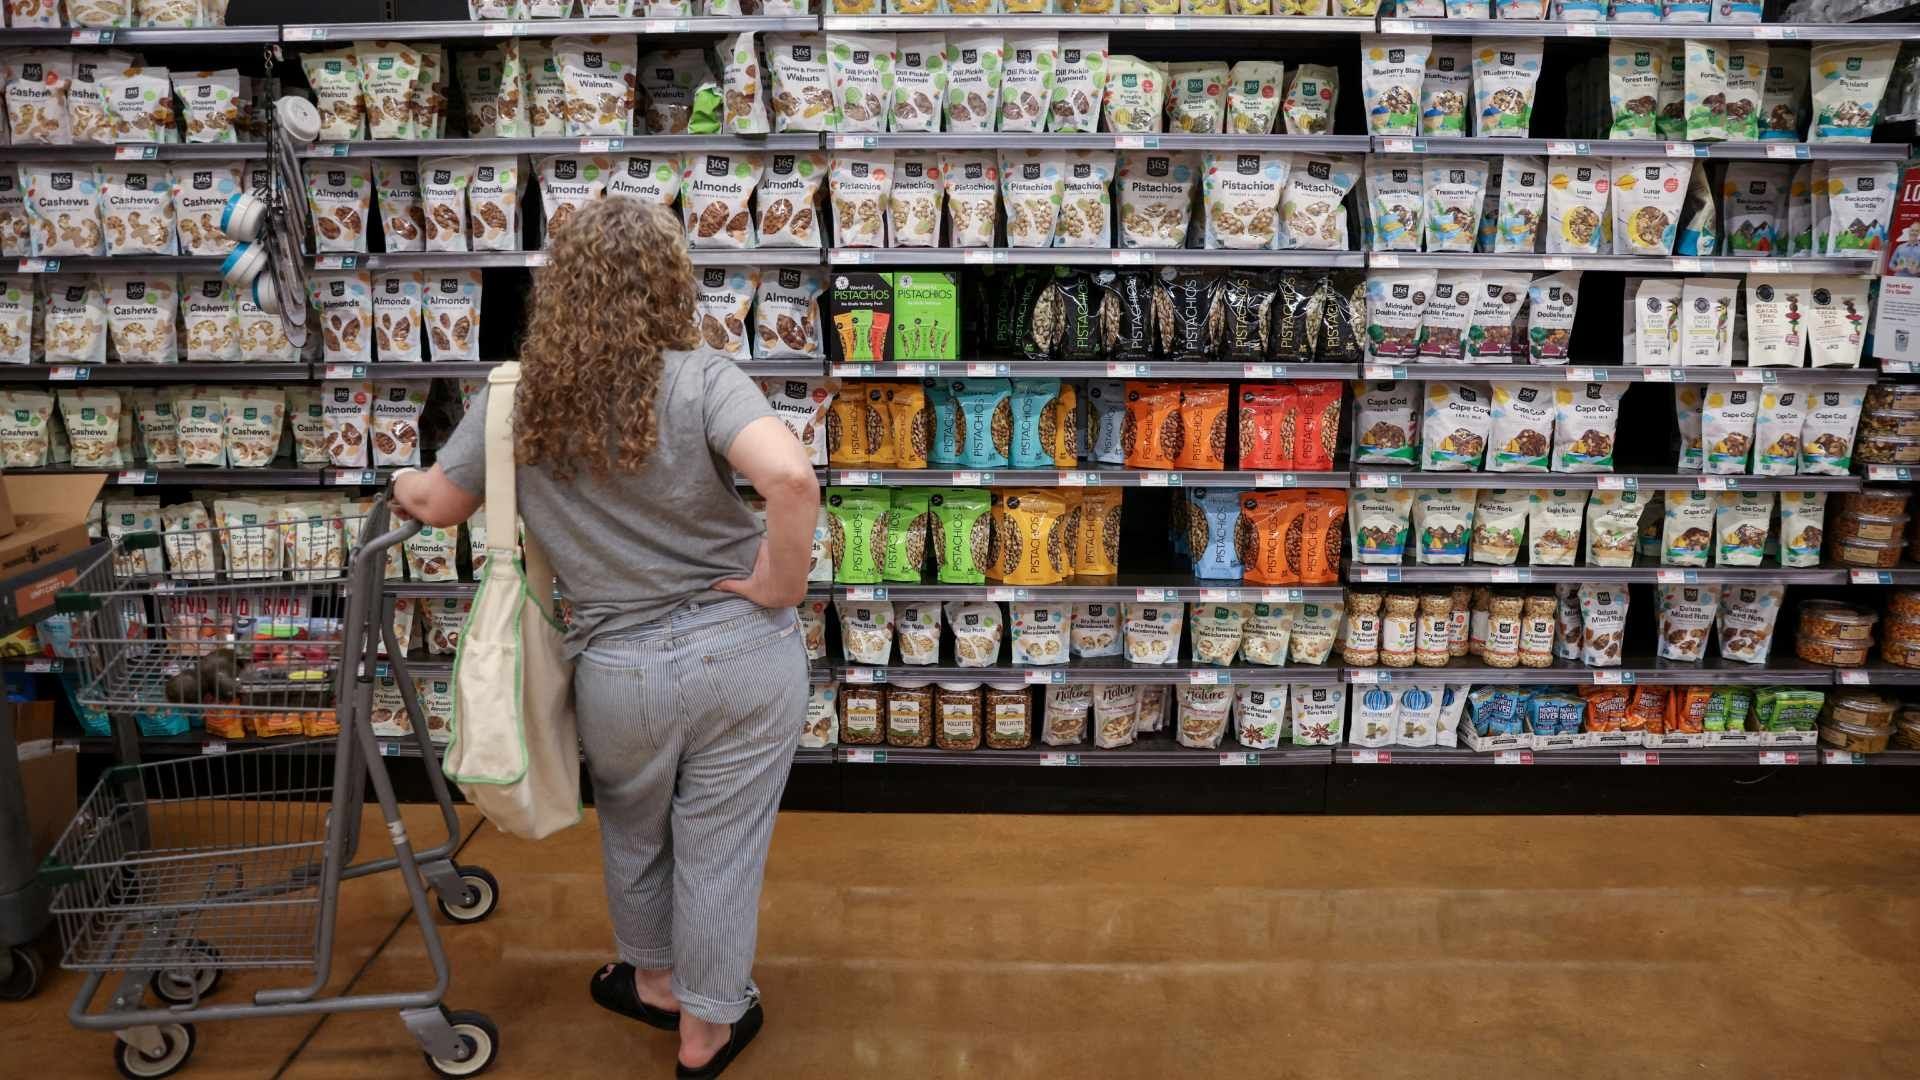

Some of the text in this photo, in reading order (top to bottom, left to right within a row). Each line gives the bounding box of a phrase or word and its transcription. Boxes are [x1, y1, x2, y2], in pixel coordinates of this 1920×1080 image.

[786, 72, 820, 82] Walnuts
[953, 75, 982, 84] Almonds
[1056, 75, 1087, 84] Almonds
[579, 80, 614, 88] Walnuts
[630, 160, 648, 172] 365
[708, 159, 728, 170] 365
[1150, 160, 1168, 170] 365
[1238, 158, 1258, 168] 365
[557, 163, 575, 174] 365
[1310, 164, 1328, 174] 365
[611, 180, 660, 195] Almonds
[692, 180, 742, 192] Almonds
[762, 178, 804, 190] Almonds
[840, 182, 881, 191] Pistachios
[894, 180, 935, 190] Pistachios
[954, 182, 995, 191] Pistachios
[1011, 182, 1052, 192] Pistachios
[1132, 182, 1183, 194] Pistachios
[1222, 180, 1275, 191] Pistachios
[1294, 181, 1344, 197] Pistachios
[316, 188, 358, 198] Almonds
[1643, 187, 1661, 195] Lunar
[39, 197, 90, 208] Cashews
[110, 196, 160, 206] Cashews
[706, 271, 723, 282] 365
[834, 289, 890, 300] PISTACHIOS
[898, 289, 952, 300] PISTACHIOS
[374, 296, 410, 306] Almonds
[430, 296, 470, 305] Almonds
[765, 292, 810, 308] Almonds
[114, 306, 158, 316] Cashews
[190, 303, 230, 313] Cashews
[1385, 302, 1412, 312] Midnight
[1428, 302, 1456, 312] Midnight
[1076, 278, 1088, 348] PISTACHIOS
[1127, 276, 1146, 350] PISTACHIOS
[1186, 279, 1198, 350] PISTACHIOS
[1236, 278, 1250, 348] PISTACHIOS
[1280, 276, 1297, 349] PISTACHIOS
[1375, 309, 1398, 317] Double
[1441, 310, 1465, 318] Feature
[1367, 398, 1408, 407] Cape Cod
[1449, 402, 1472, 413] Cape
[324, 406, 362, 414] Almonds
[376, 404, 417, 414] Almonds
[1575, 404, 1596, 414] Cape
[1722, 412, 1740, 420] Cape
[1815, 412, 1832, 420] Cape
[181, 426, 218, 434] Cashews
[232, 428, 270, 436] Cashews
[851, 402, 860, 456] PISTACHIOS
[973, 398, 985, 458] PISTACHIOS
[1020, 398, 1033, 456] PISTACHIOS
[1192, 402, 1204, 462] PISTACHIOS
[1302, 398, 1314, 460] PISTACHIOS
[70, 428, 108, 437] Cashews
[1736, 505, 1767, 514] Cape Cod
[1084, 502, 1098, 564] PISTACHIOS
[1216, 506, 1227, 564] PISTACHIOS
[852, 512, 864, 572] PISTACHIOS
[888, 510, 900, 570] PISTACHIOS
[952, 512, 964, 572] PISTACHIOS
[1267, 513, 1279, 574] PISTACHIOS
[1307, 513, 1319, 572] PISTACHIOS
[410, 544, 444, 552] Almonds
[1670, 611, 1710, 620] Mixed Nuts
[1747, 614, 1764, 622] Nuts
[1134, 622, 1146, 630] Dry
[1204, 626, 1214, 634] Dry
